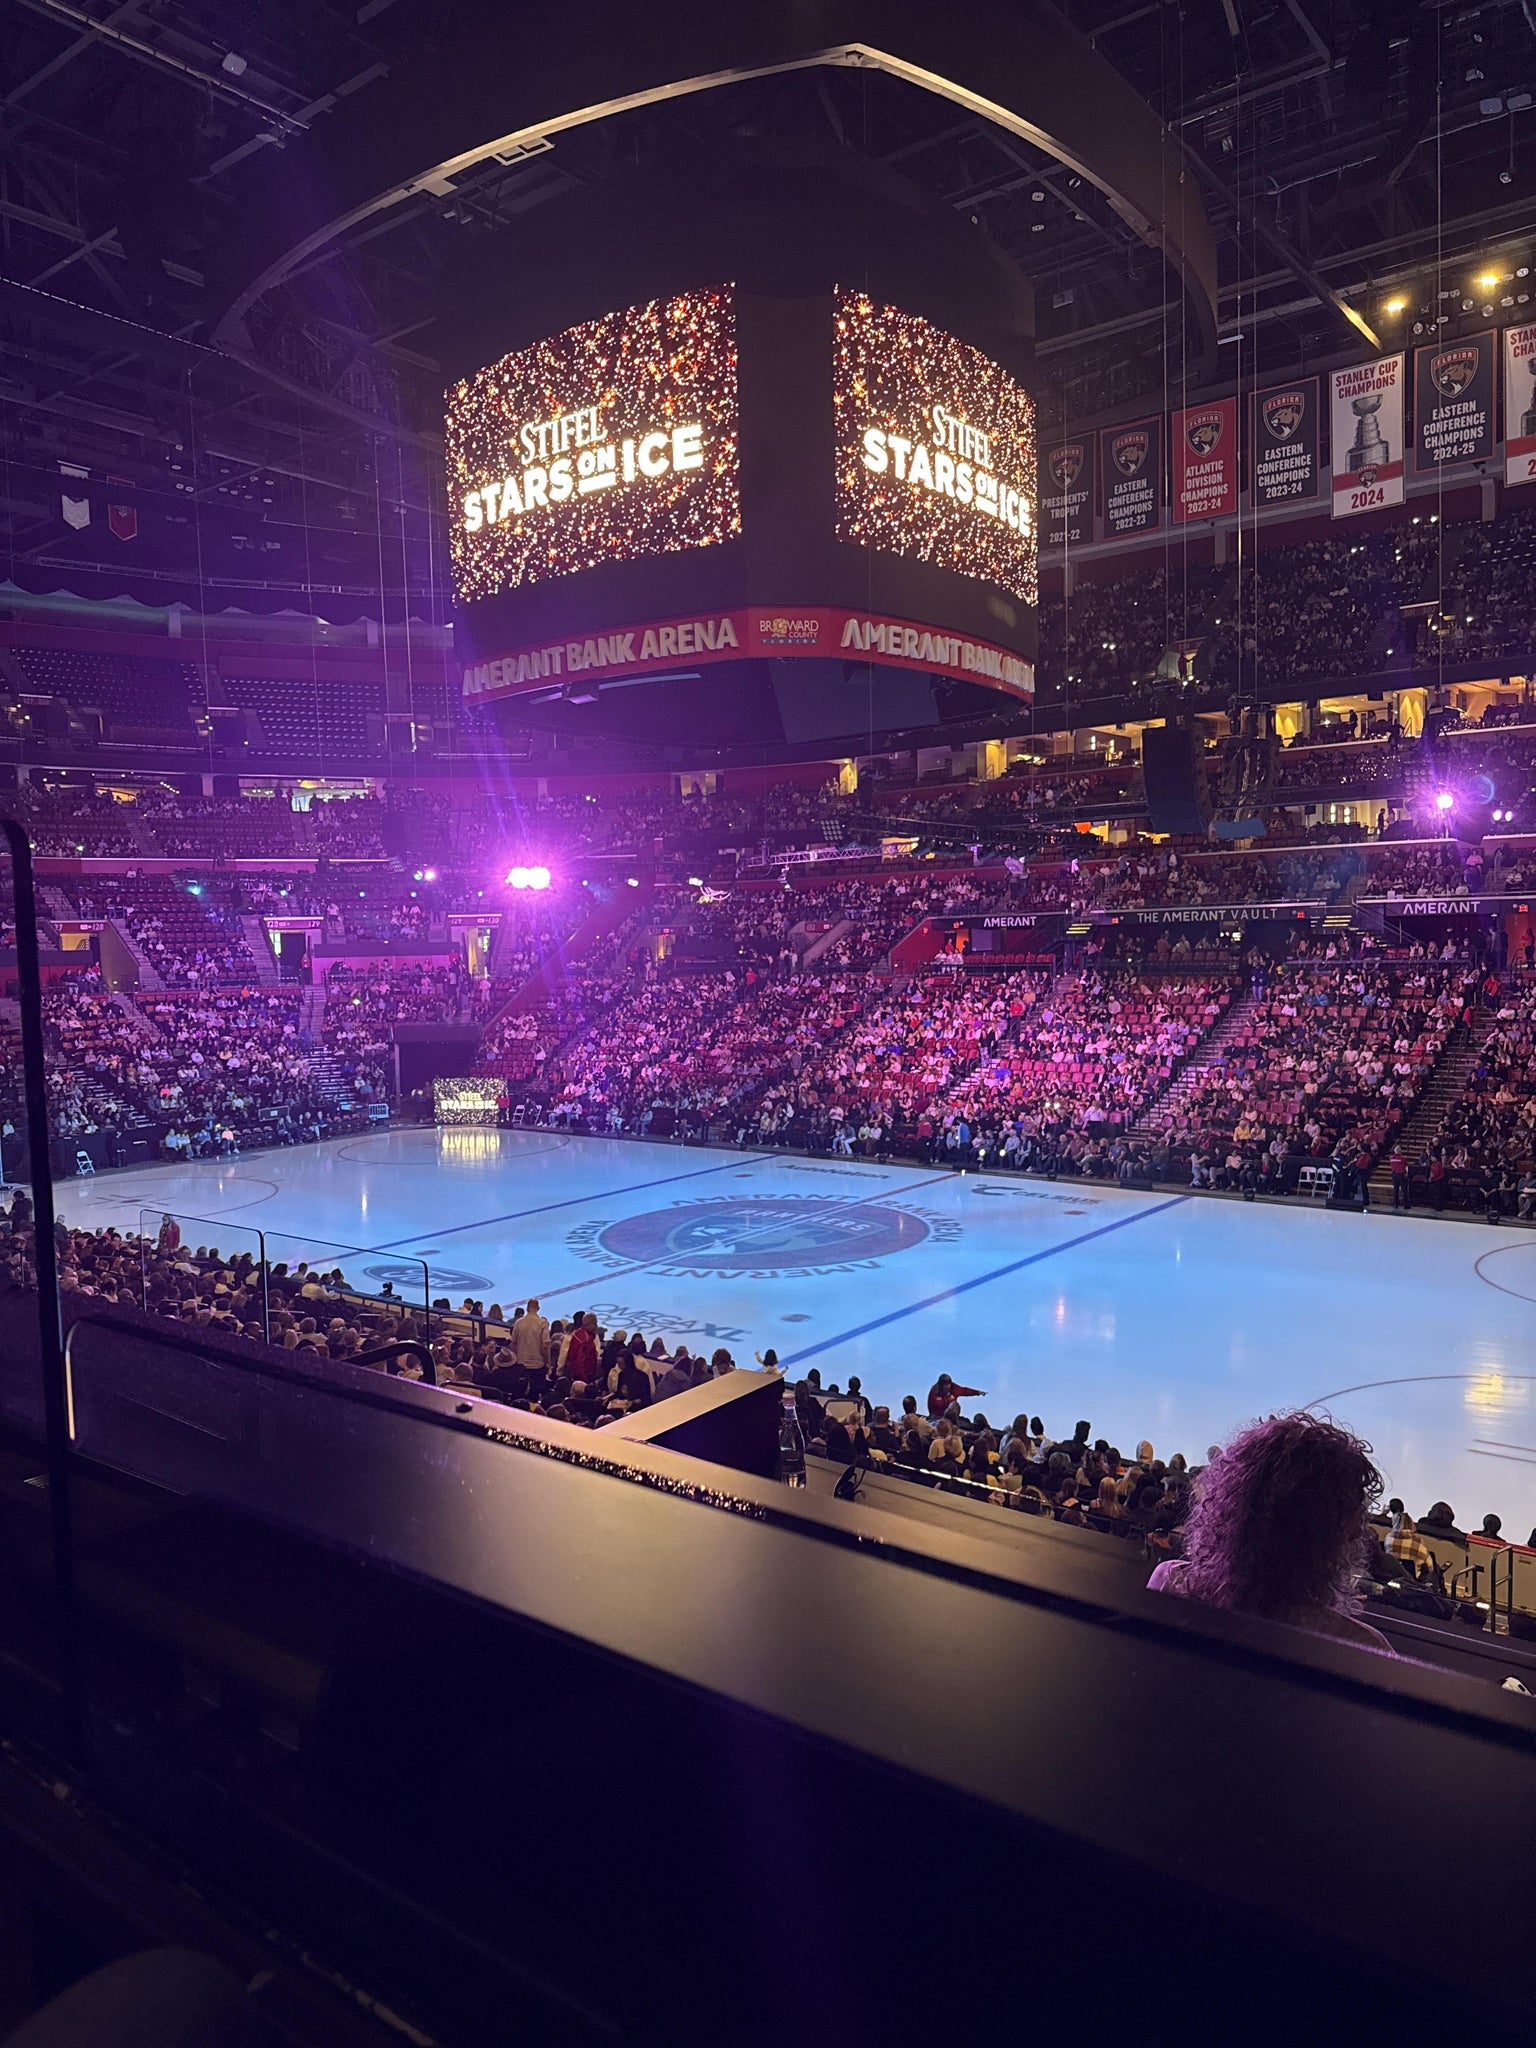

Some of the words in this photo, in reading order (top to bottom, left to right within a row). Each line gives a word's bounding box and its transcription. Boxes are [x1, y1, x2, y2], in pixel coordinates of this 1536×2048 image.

[1437, 351, 1473, 366] FLORIDA
[1335, 366, 1376, 387] STANLEY
[1378, 360, 1398, 376] CUP
[1338, 374, 1396, 400] CHAMPIONS
[1267, 396, 1300, 409] FLORIDA
[1432, 400, 1476, 421] EASTERN
[1423, 412, 1486, 436] CONFERENCE
[520, 406, 608, 466] STIFEL
[933, 405, 994, 470] STIFEL
[1425, 426, 1484, 449] CHAMPIONS
[1264, 442, 1303, 461] EASTERN
[1433, 441, 1475, 461] 2024-25
[1186, 460, 1224, 478] ATLANTIC
[1257, 454, 1312, 475] CONFERENCE
[465, 458, 573, 532] STARS
[577, 445, 616, 476] ON
[622, 424, 704, 482] ICE
[863, 429, 974, 504] STARS
[975, 471, 998, 501] ON
[999, 483, 1031, 537] ICE
[1114, 478, 1147, 495] EASTERN
[1186, 472, 1223, 490] DIVISION
[1258, 467, 1311, 487] CHAMPIONS
[1041, 491, 1089, 509] PRESIDENTS'
[1108, 488, 1155, 509] CONFERENCE
[1181, 484, 1228, 503] CHAMPIONS
[1265, 482, 1303, 499] 2023-24
[1351, 487, 1385, 509] 2024
[1050, 505, 1080, 520] TROPHY
[1109, 501, 1153, 521] CHAMPIONS
[1187, 498, 1221, 514] 2023-24
[1115, 514, 1147, 531] 2022-23
[759, 618, 819, 634] BROWARD
[462, 646, 565, 696] AMERANT
[566, 632, 636, 672] BANK
[640, 618, 739, 660] ARENA
[840, 618, 962, 667] AMERANT
[962, 644, 1003, 679] BANK
[1137, 912, 1159, 923] THE
[1162, 910, 1226, 922] AMERANT
[1230, 908, 1278, 919] VAULT
[1403, 901, 1481, 915] AMERANT
[983, 916, 1037, 927] AMERANT
[1012, 1191, 1103, 1204] CELSIUS
[671, 1193, 860, 1206] AMERANT
[874, 1200, 946, 1218] BANK
[926, 1218, 963, 1242] ARENA
[734, 1209, 872, 1231] PANTHERS
[565, 1220, 616, 1244] ARENA
[567, 1245, 635, 1268] BANK
[644, 1260, 882, 1279] AMERANT
[590, 1303, 697, 1329] OMEGA
